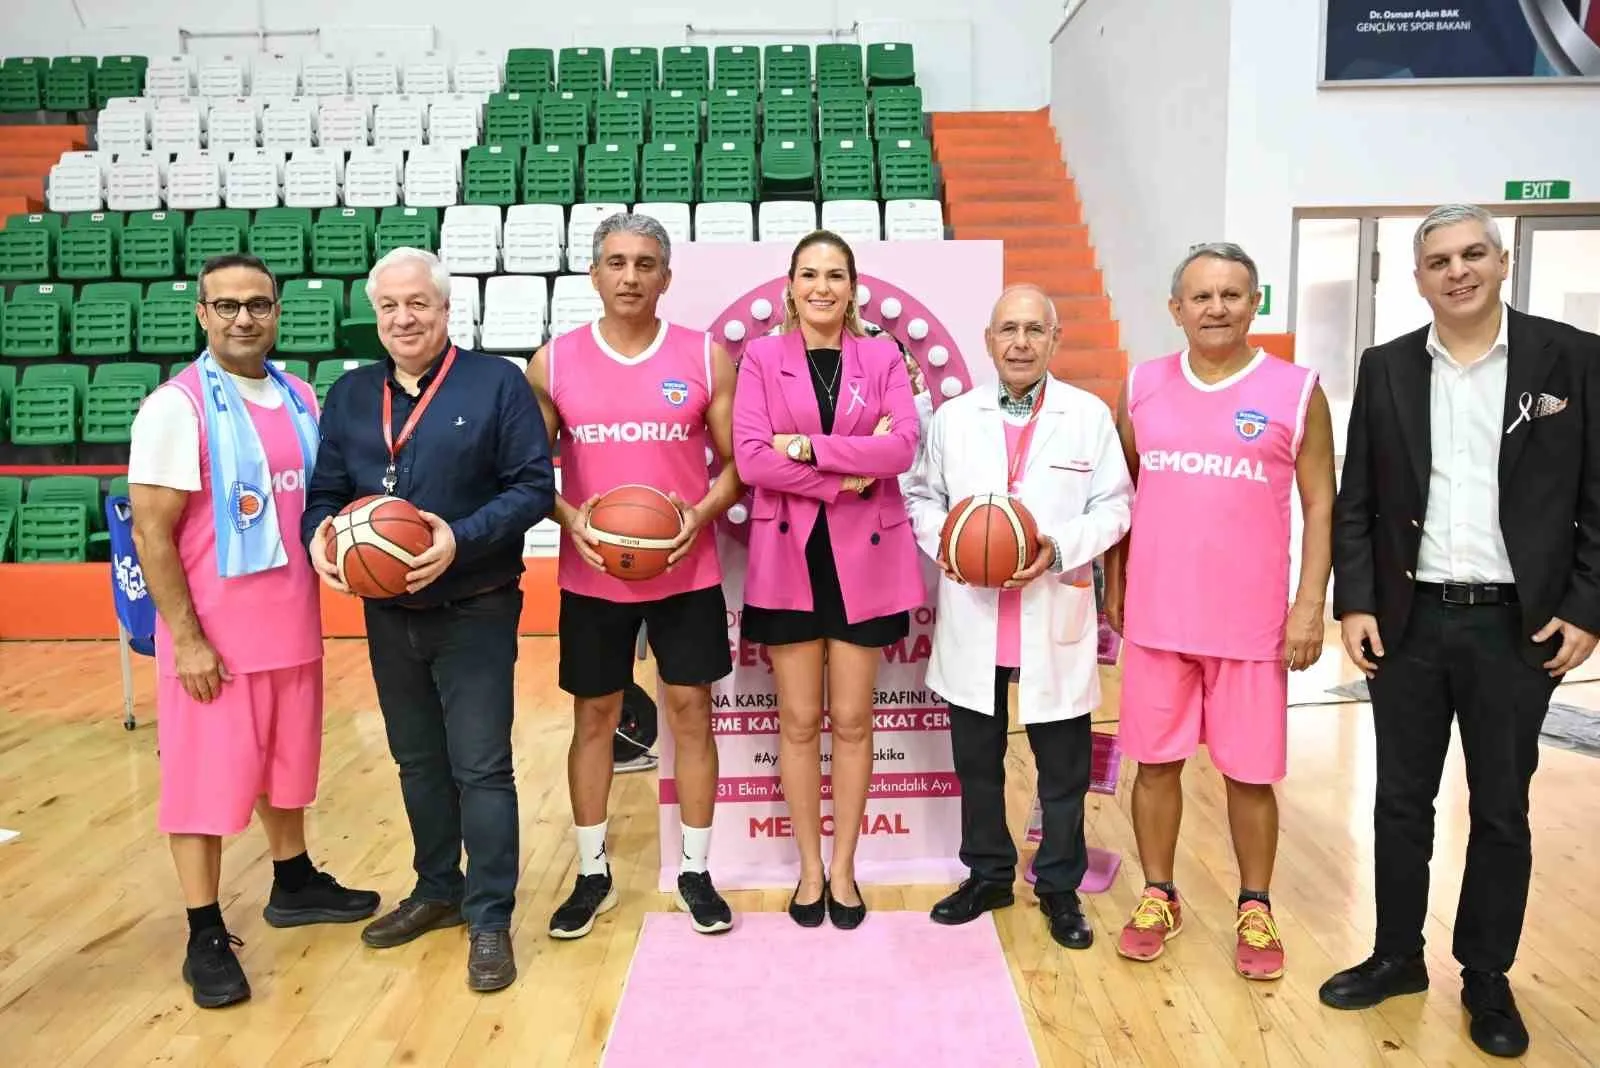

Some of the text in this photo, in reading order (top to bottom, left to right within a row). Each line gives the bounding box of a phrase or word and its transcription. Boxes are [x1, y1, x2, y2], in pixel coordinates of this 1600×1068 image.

[1370, 10, 1382, 19] Dr.
[1384, 10, 1414, 19] Osman
[1441, 9, 1459, 17] BAK
[1357, 21, 1471, 33] GENÇLİK VE SPOR BAKANI
[1522, 183, 1553, 198] EXIT
[736, 694, 778, 709] KARŞI
[872, 688, 926, 705] ĞRAFINI
[872, 713, 918, 728] KKAT
[738, 781, 767, 795] Ekim
[868, 778, 928, 793] arkındalık
[931, 779, 952, 794] Ayı
